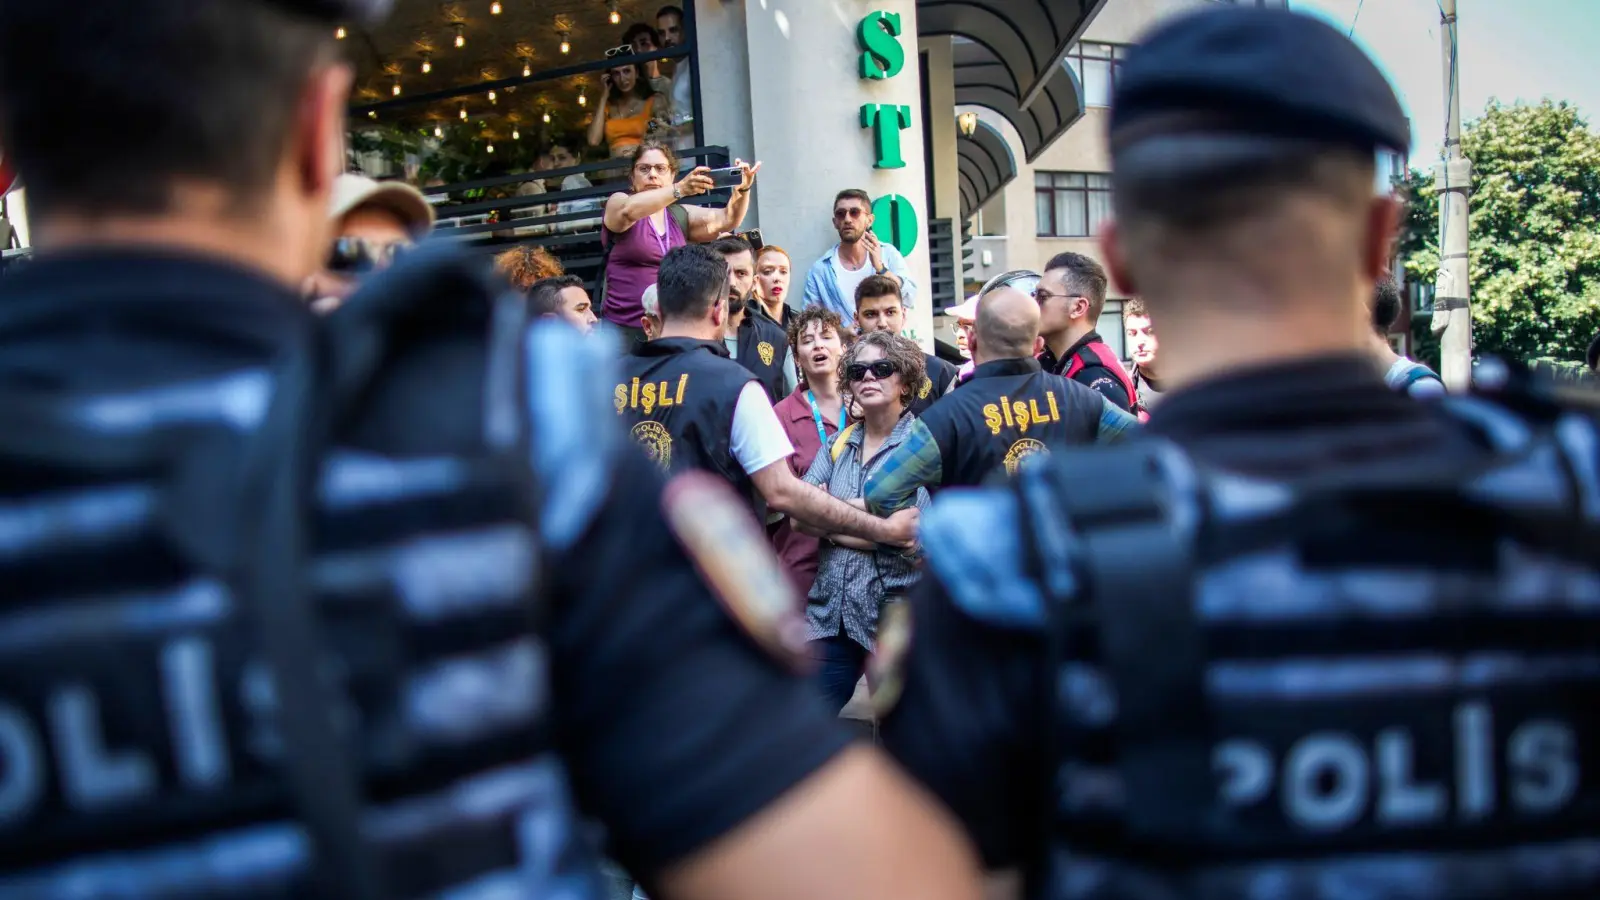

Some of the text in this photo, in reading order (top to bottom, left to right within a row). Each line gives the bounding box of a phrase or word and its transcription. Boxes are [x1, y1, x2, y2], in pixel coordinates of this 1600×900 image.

[613, 373, 689, 415] ŞİŞLİ
[983, 391, 1060, 435] ŞİŞLİ
[635, 423, 661, 434] POLİS
